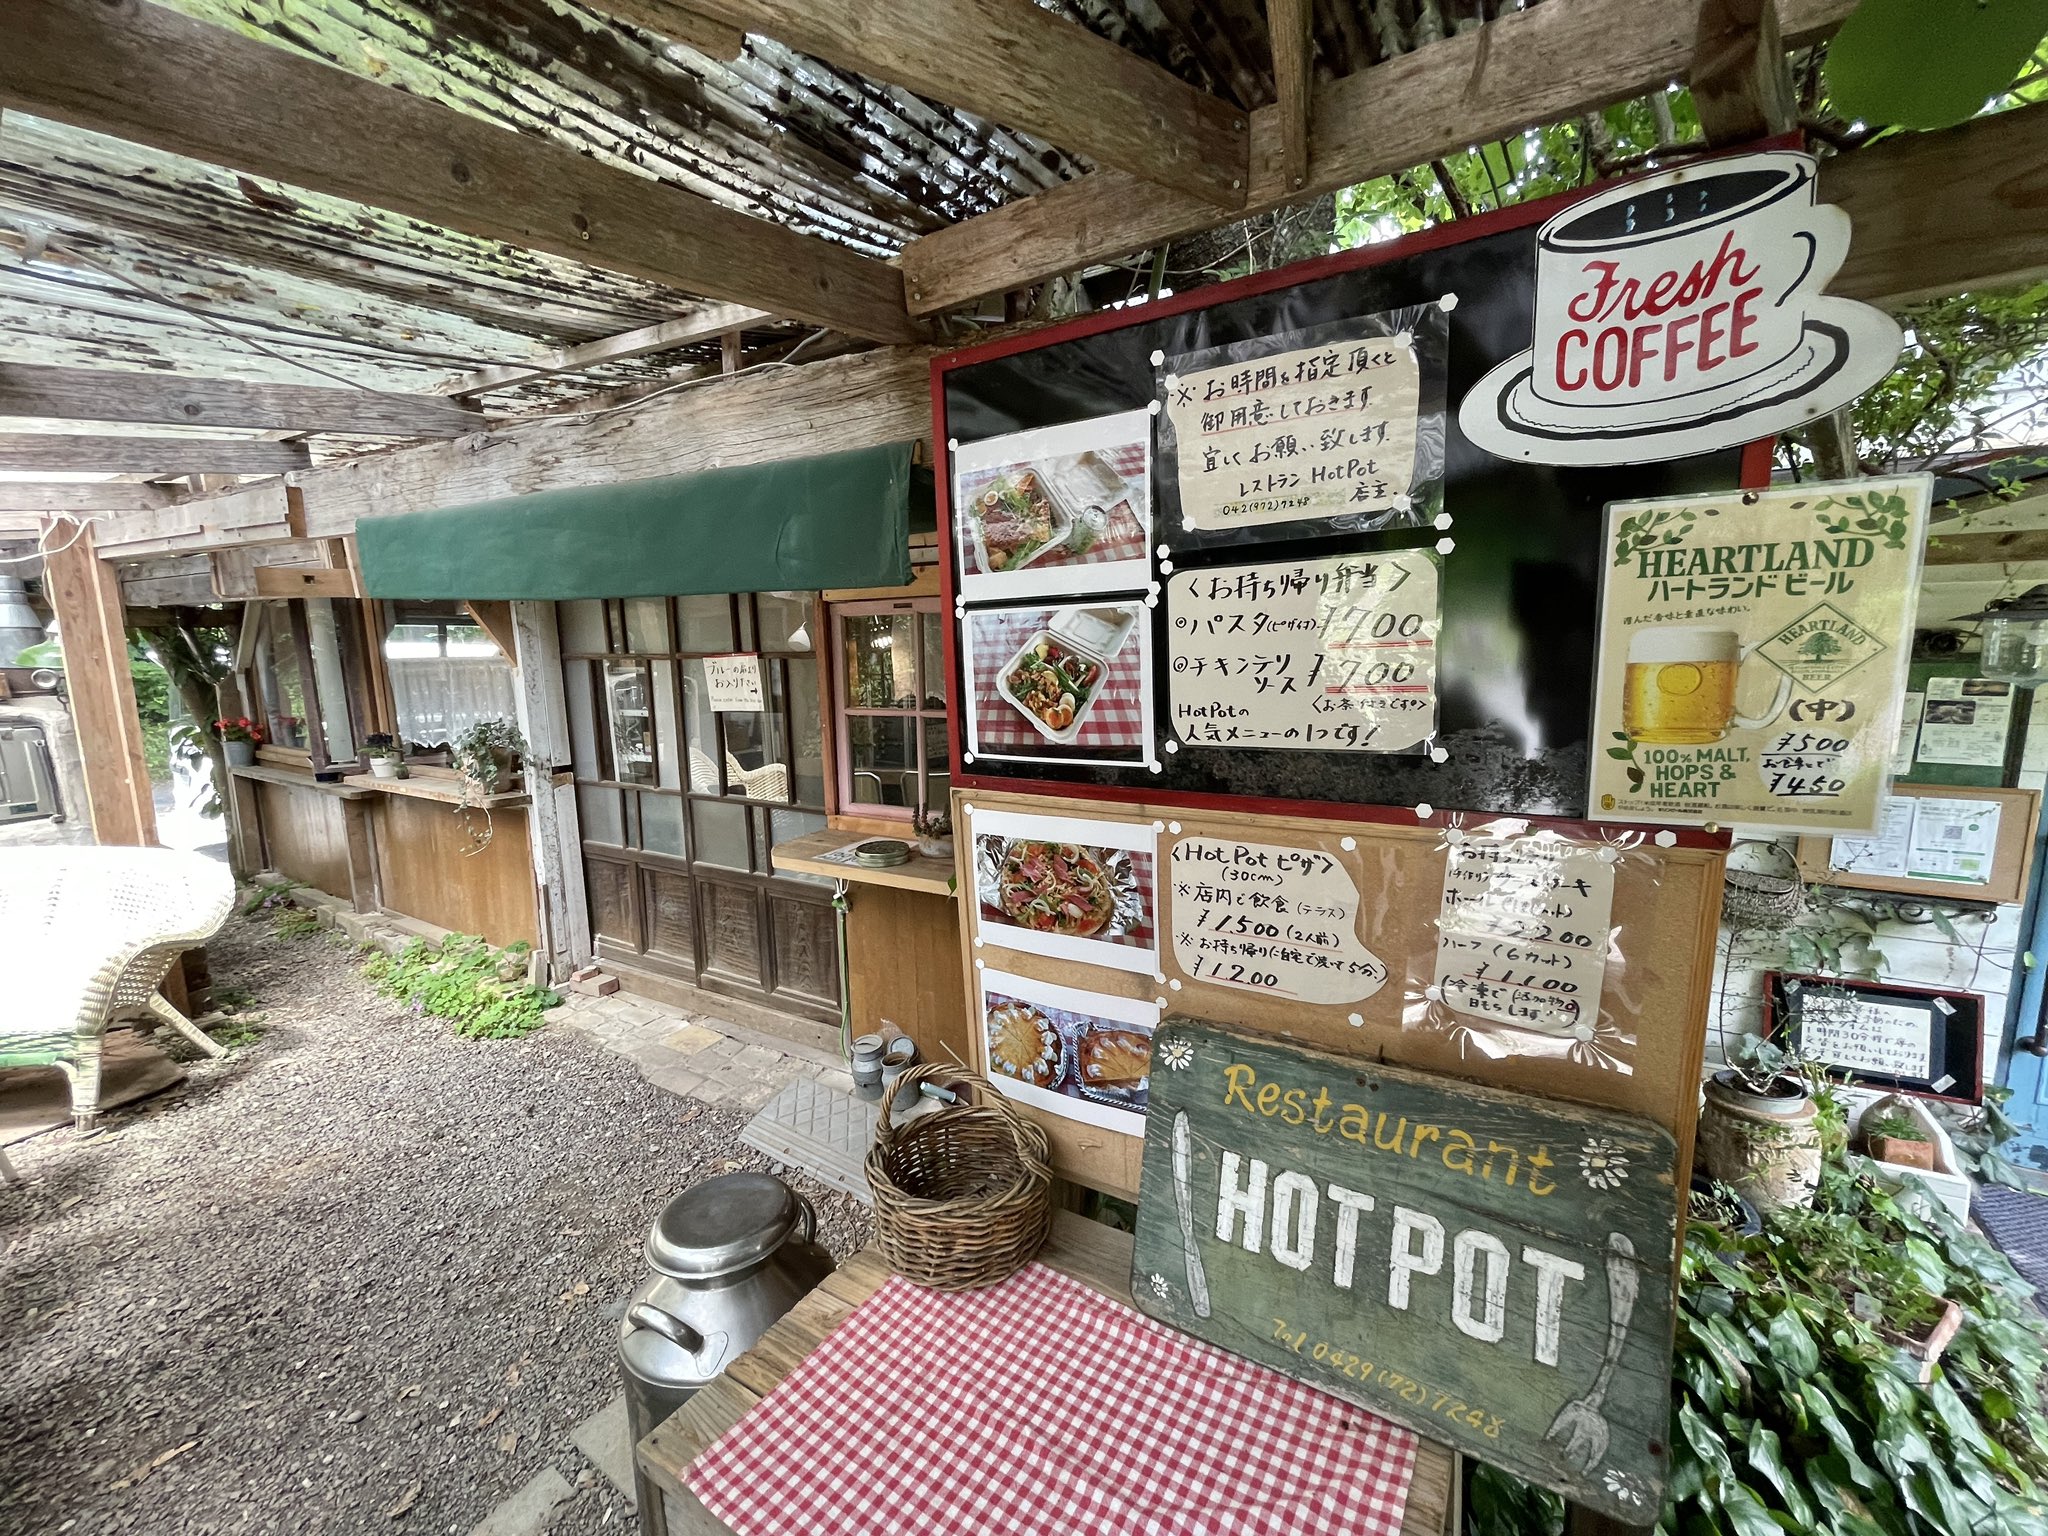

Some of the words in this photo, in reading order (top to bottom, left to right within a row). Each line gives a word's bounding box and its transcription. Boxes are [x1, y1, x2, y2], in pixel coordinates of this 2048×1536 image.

[1567, 230, 1760, 323] Fresh
[1555, 287, 1764, 391] COFFEE
[1240, 473, 1300, 497] レストラン
[1636, 537, 1875, 580] HEARTLAND
[1778, 619, 1866, 646] HEARTLAND
[1254, 676, 1297, 694] ソース
[1644, 749, 1692, 765] 100%
[1656, 764, 1713, 780] HOPS
[1719, 763, 1737, 780] &
[1650, 781, 1721, 798] HEART
[1223, 1063, 1556, 1196] Restaurant
[1215, 1150, 1375, 1290] HOT
[1388, 1205, 1584, 1368] POT
